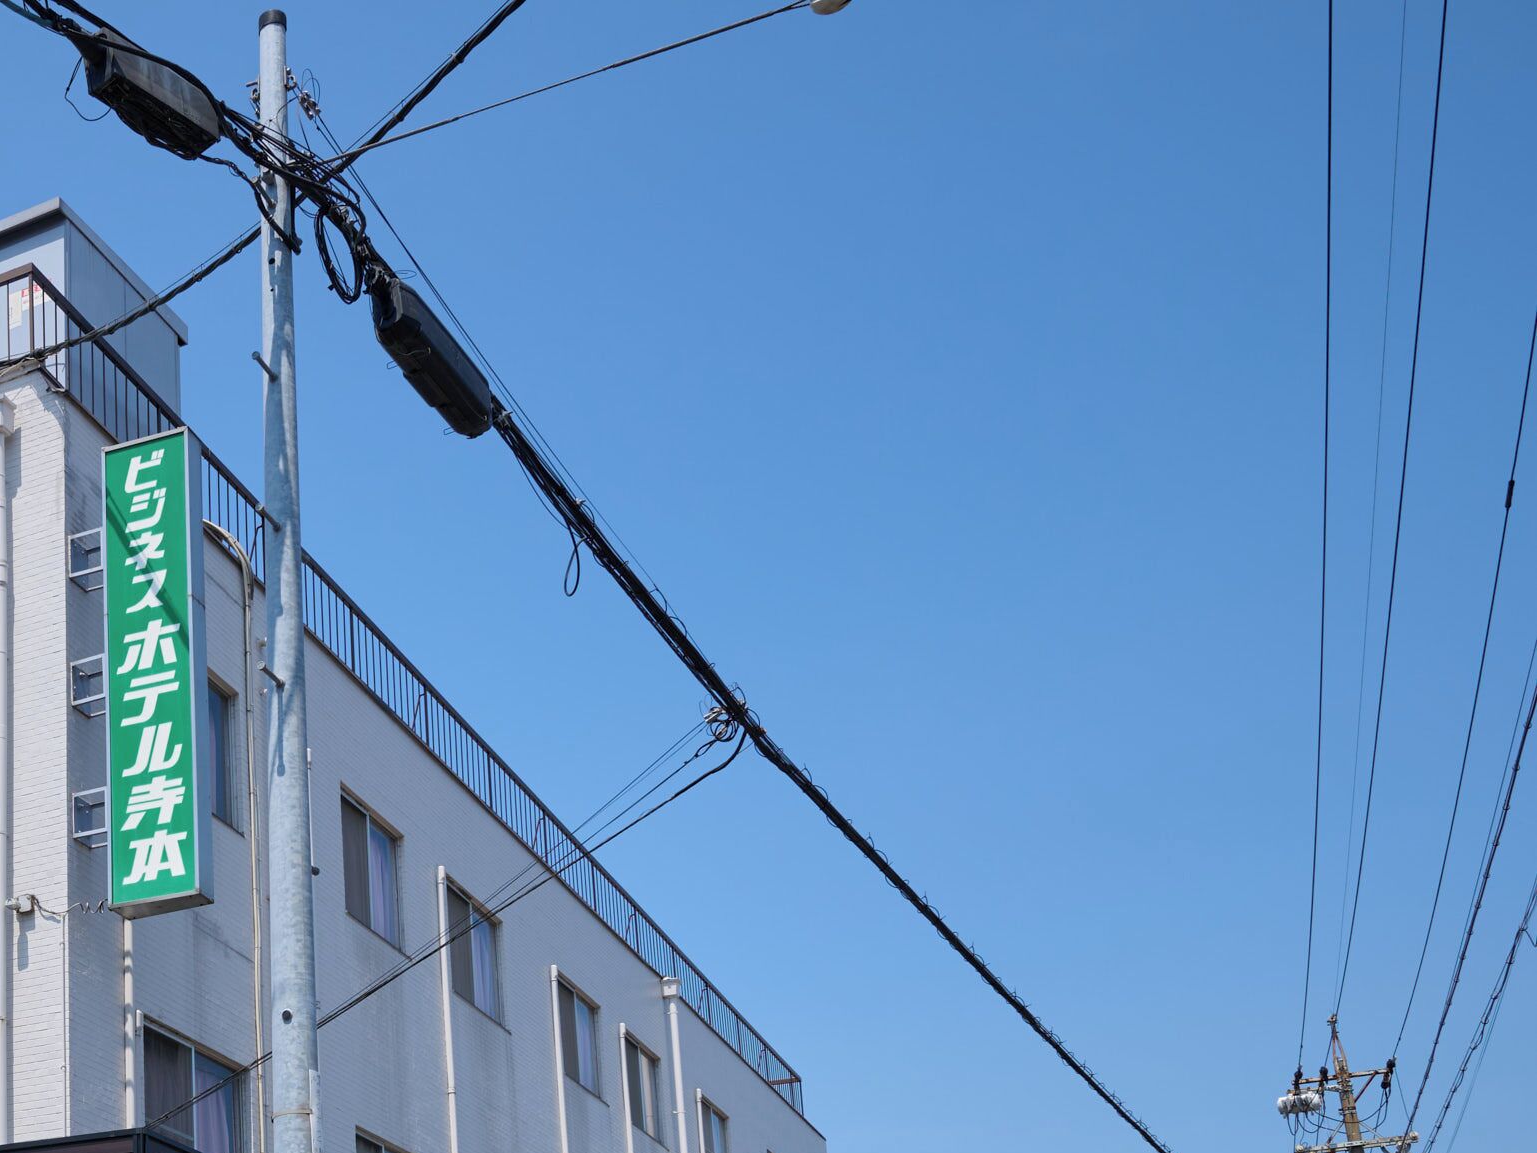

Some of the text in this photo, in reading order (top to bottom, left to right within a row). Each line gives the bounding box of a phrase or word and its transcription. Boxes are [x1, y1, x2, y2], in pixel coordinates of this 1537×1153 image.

[117, 448, 186, 885] ビジネスホテル寺本
